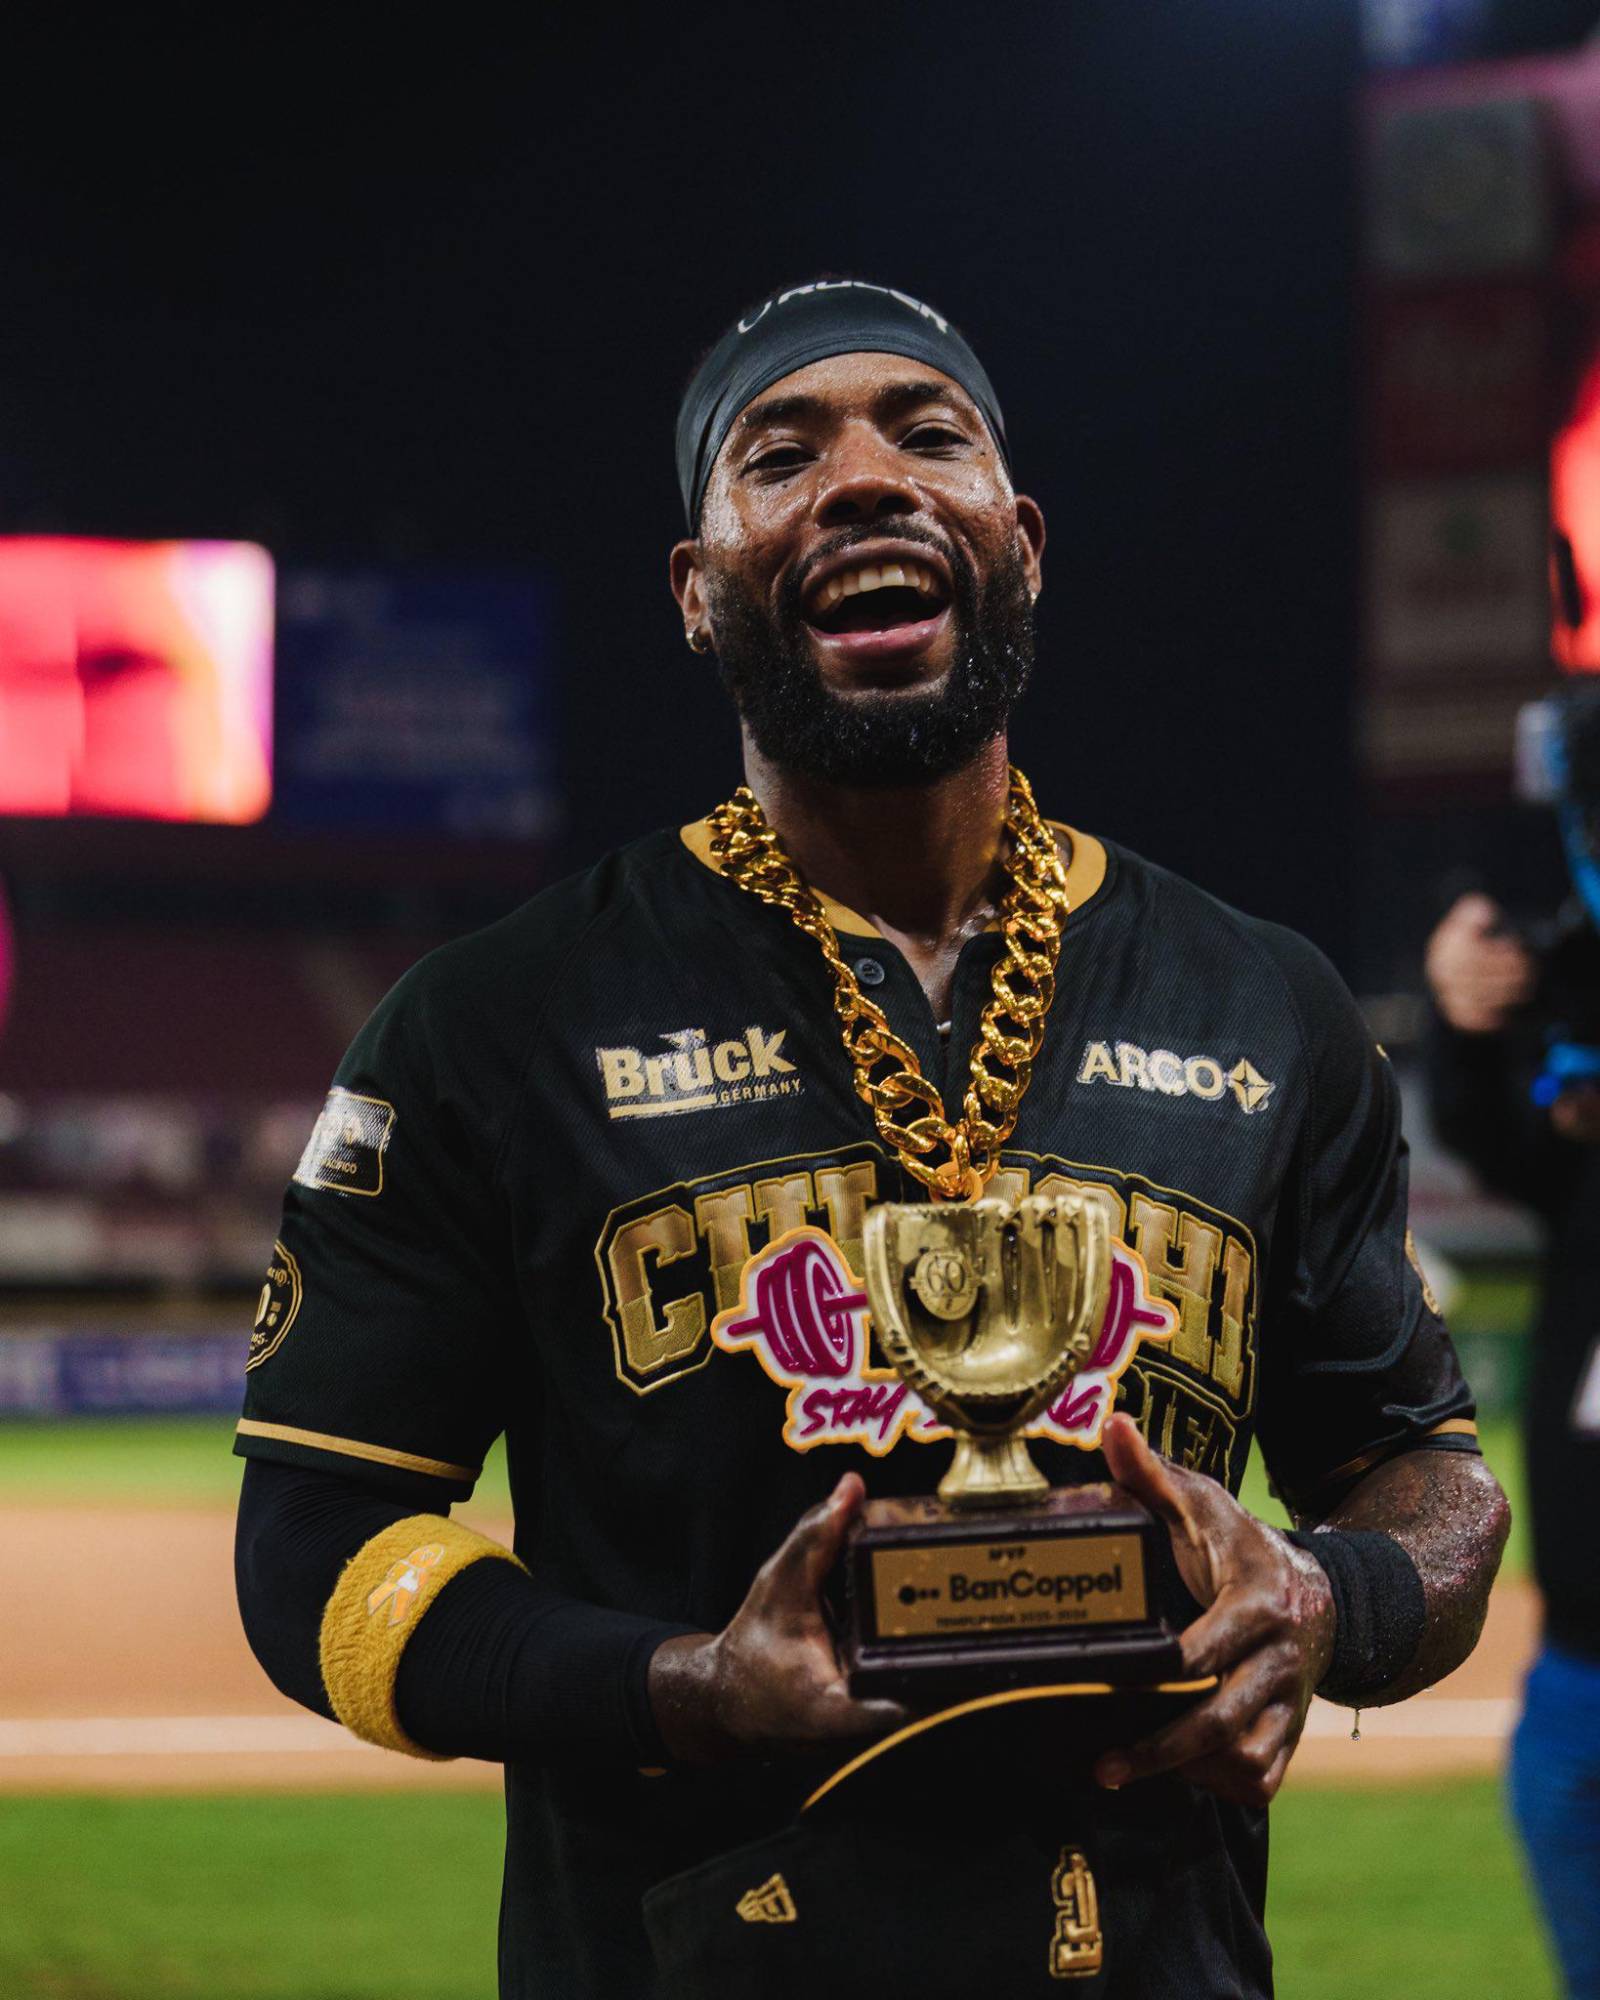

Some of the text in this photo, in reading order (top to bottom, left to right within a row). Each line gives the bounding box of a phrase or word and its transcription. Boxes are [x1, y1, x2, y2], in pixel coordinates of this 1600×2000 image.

[720, 1078, 802, 1103] GERMANY
[1077, 1041, 1227, 1100] ARCO
[800, 1383, 907, 1440] STAY
[949, 1564, 1122, 1602] BanCoppel
